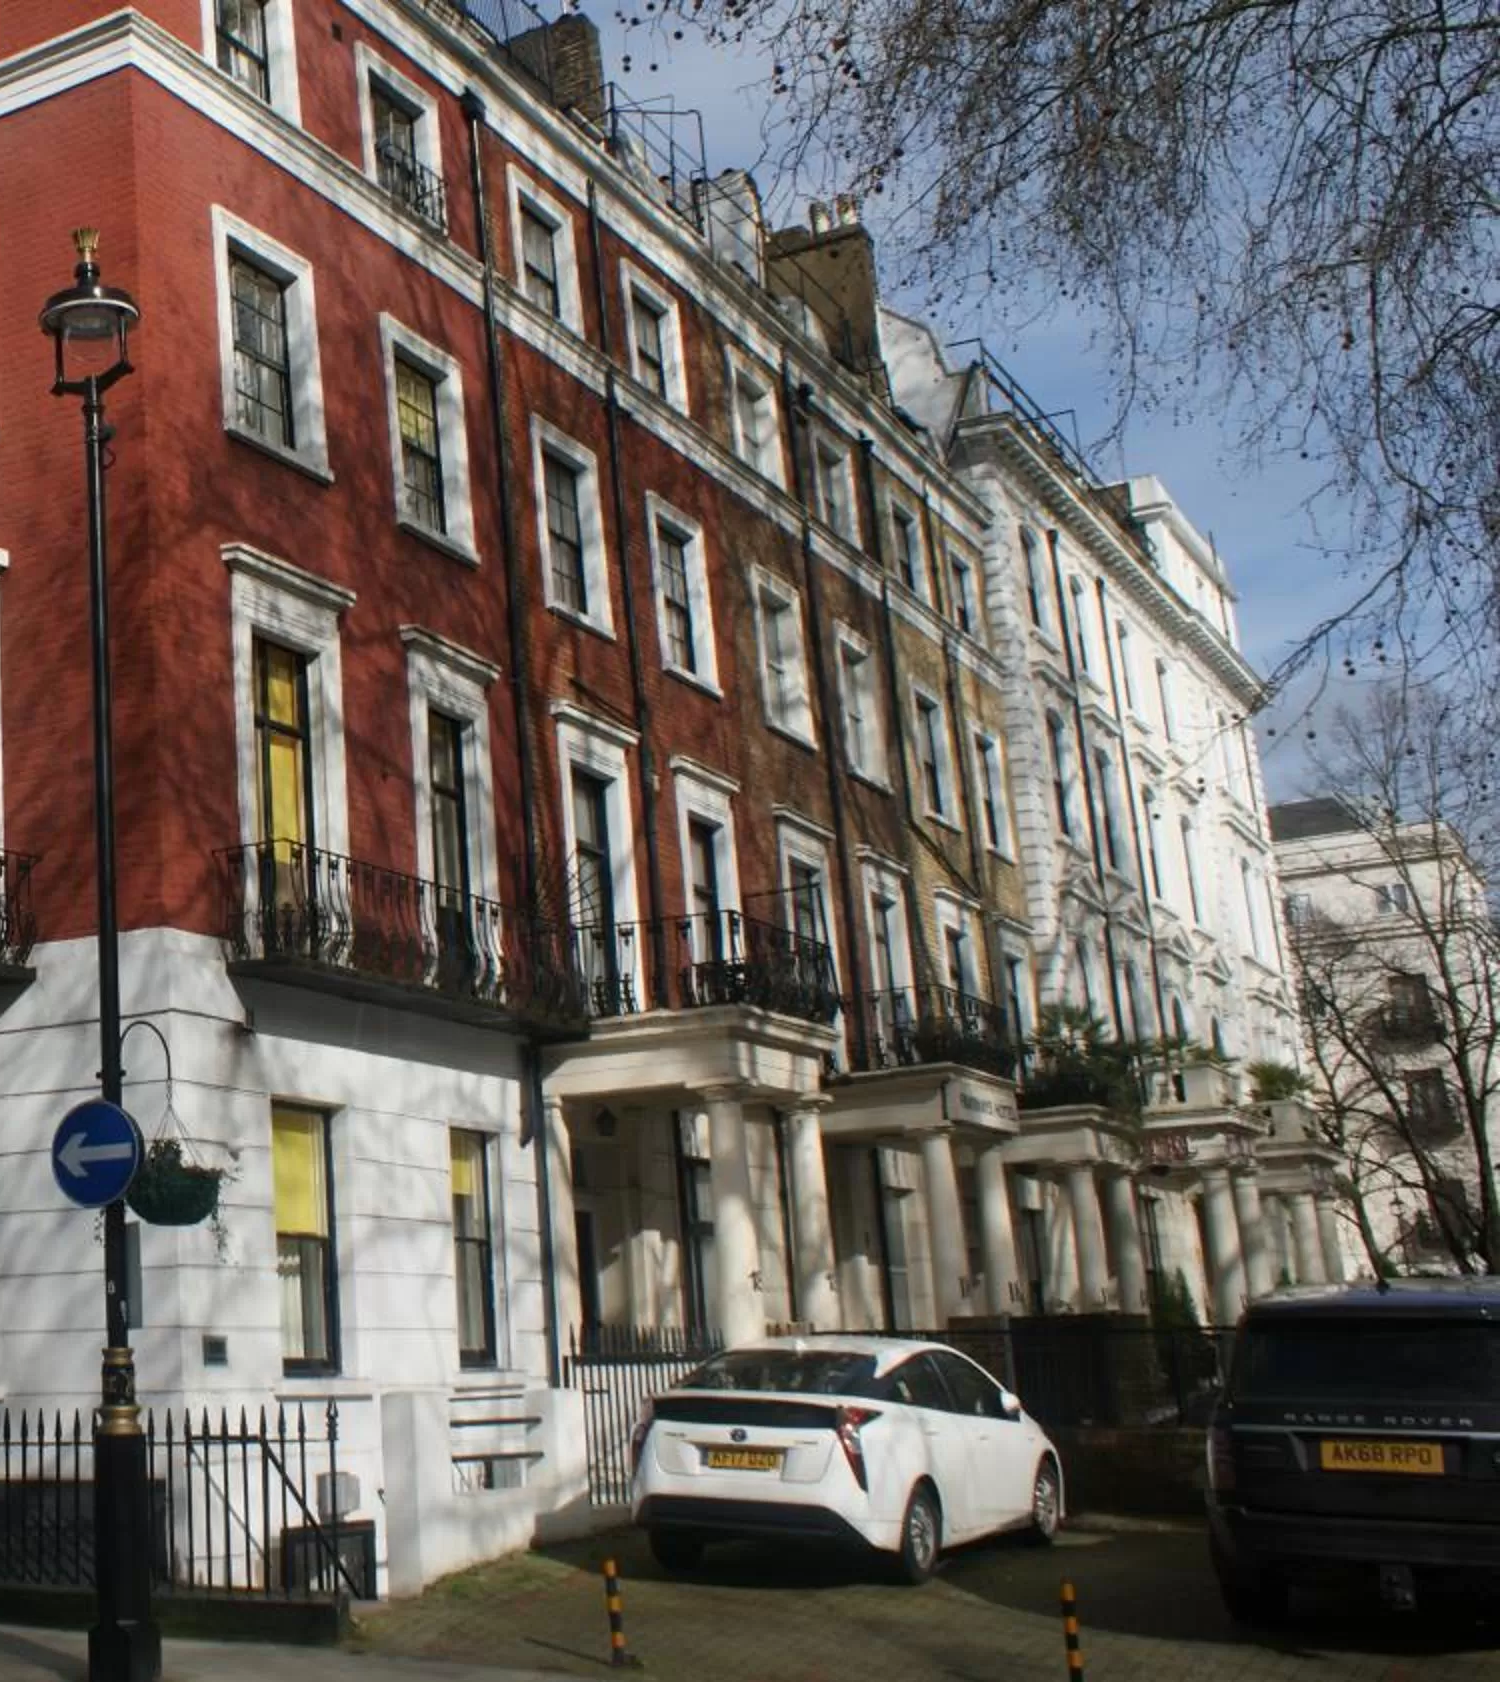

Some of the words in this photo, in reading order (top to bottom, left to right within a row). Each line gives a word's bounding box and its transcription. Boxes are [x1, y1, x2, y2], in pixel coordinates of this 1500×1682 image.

[1284, 1413, 1367, 1424] RANGE
[1383, 1416, 1474, 1427] ROVER
[1331, 1443, 1385, 1464] AK68
